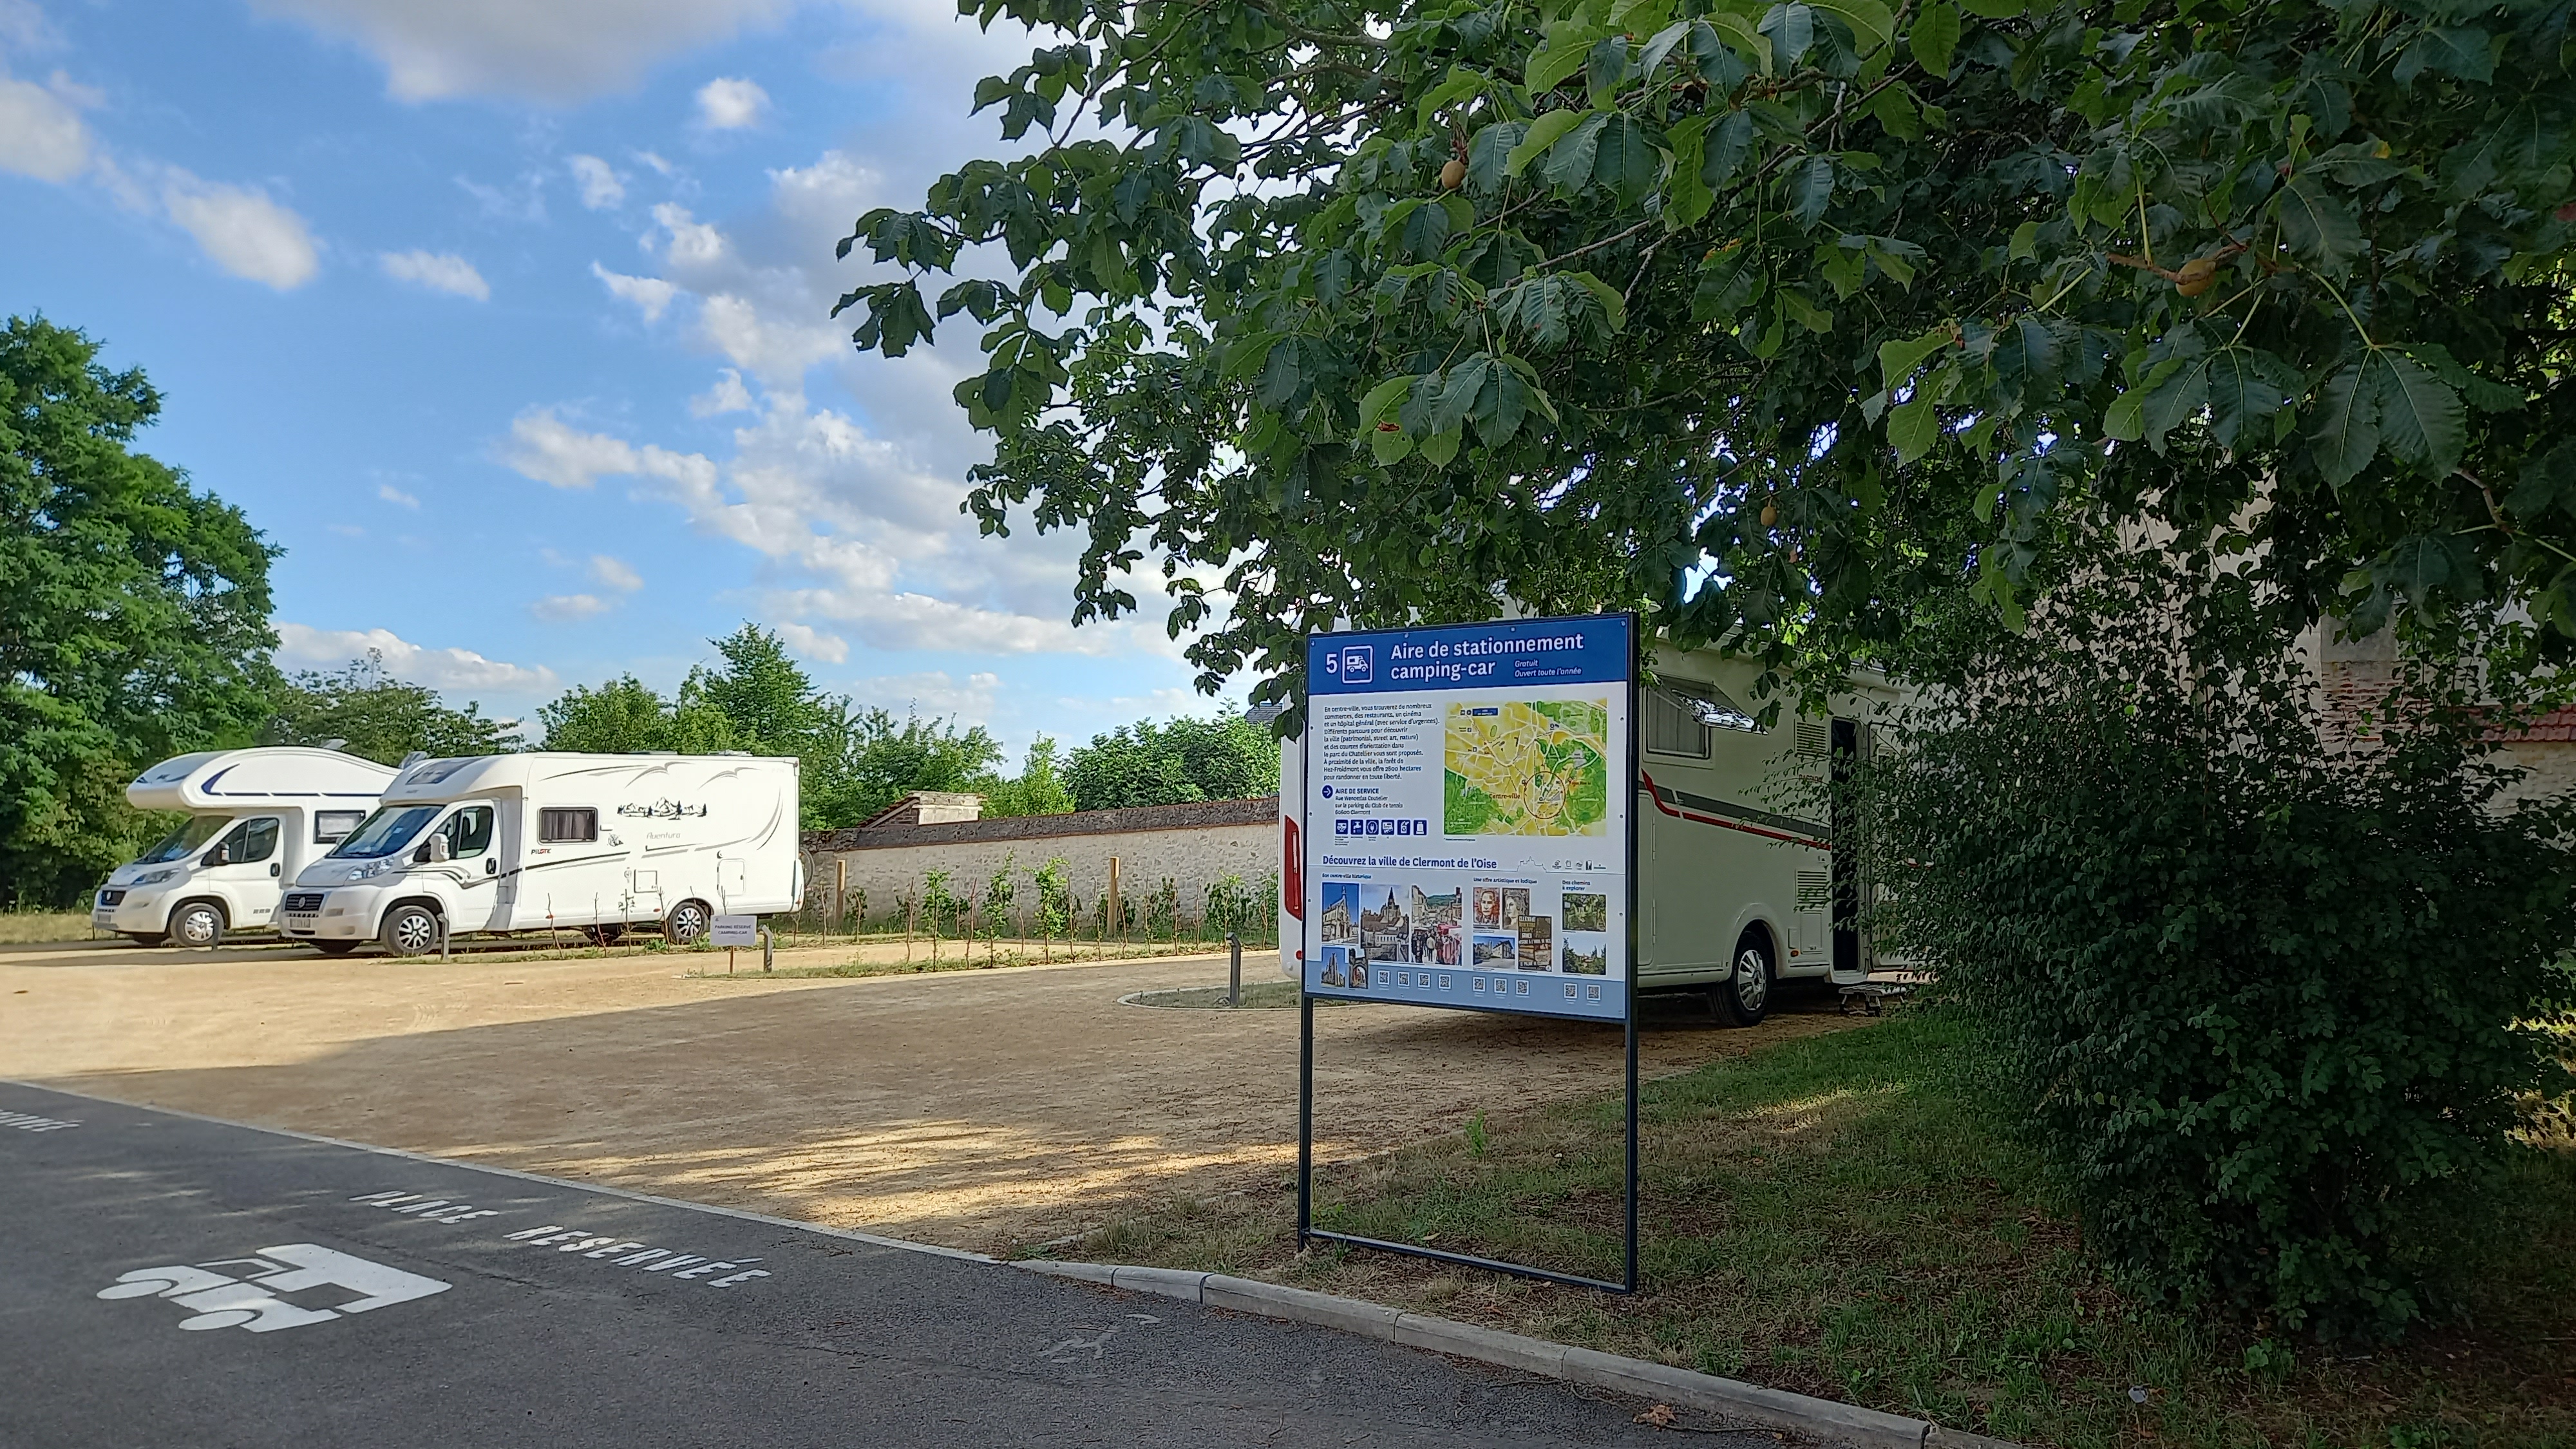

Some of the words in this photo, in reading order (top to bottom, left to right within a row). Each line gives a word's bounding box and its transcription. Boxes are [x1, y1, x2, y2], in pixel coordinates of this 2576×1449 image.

[1325, 653, 1338, 674] 5
[1390, 642, 1424, 660] Aire
[1429, 640, 1448, 658] de
[1454, 633, 1584, 656] stationnement
[1391, 661, 1495, 682] camping-car
[1323, 855, 1366, 865] Découvrez
[1368, 856, 1376, 866] la
[1379, 857, 1397, 866] ville
[1399, 857, 1410, 867] de
[1412, 857, 1455, 867] Clermont
[1457, 858, 1468, 868] de
[1472, 858, 1497, 869] l'Oise
[348, 1189, 499, 1223] PLACE
